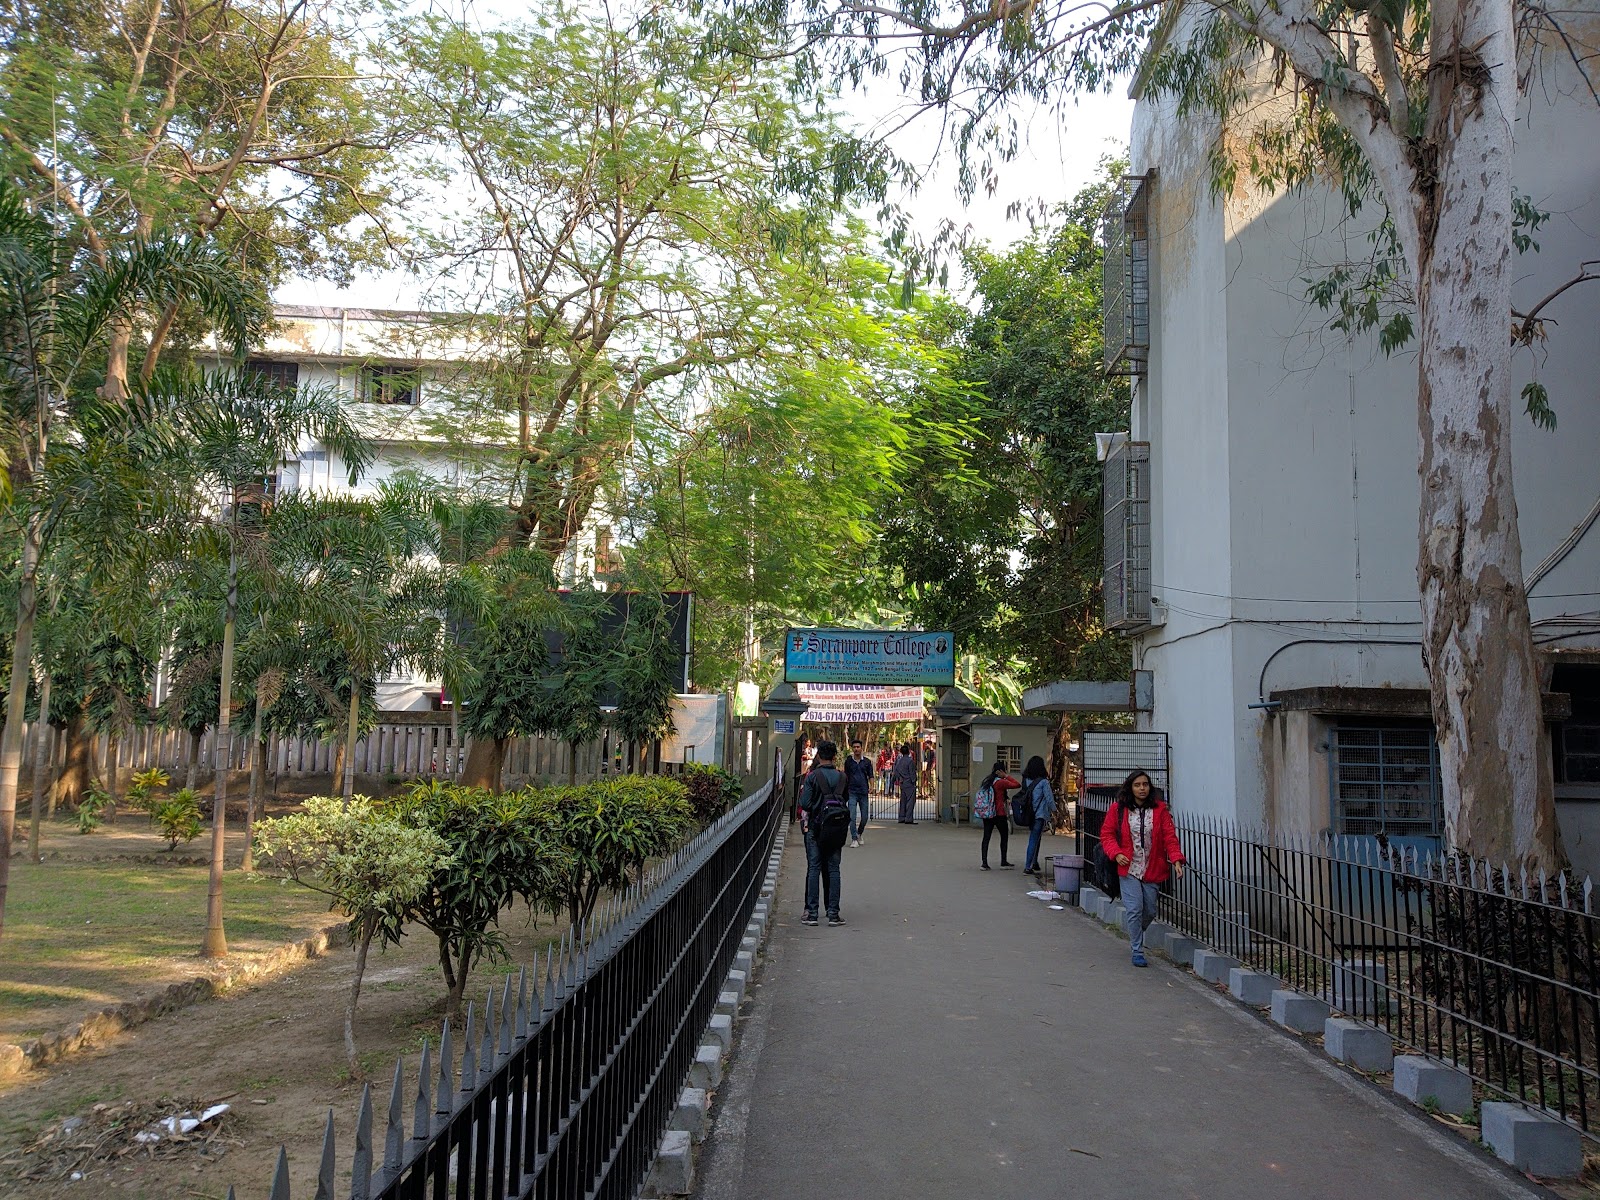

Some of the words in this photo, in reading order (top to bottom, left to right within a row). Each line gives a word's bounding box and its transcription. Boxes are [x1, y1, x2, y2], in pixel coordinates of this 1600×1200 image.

[807, 632, 878, 657] Serampore
[884, 635, 931, 659] College
[827, 702, 845, 710] Classes
[890, 699, 919, 709] Curriculum
